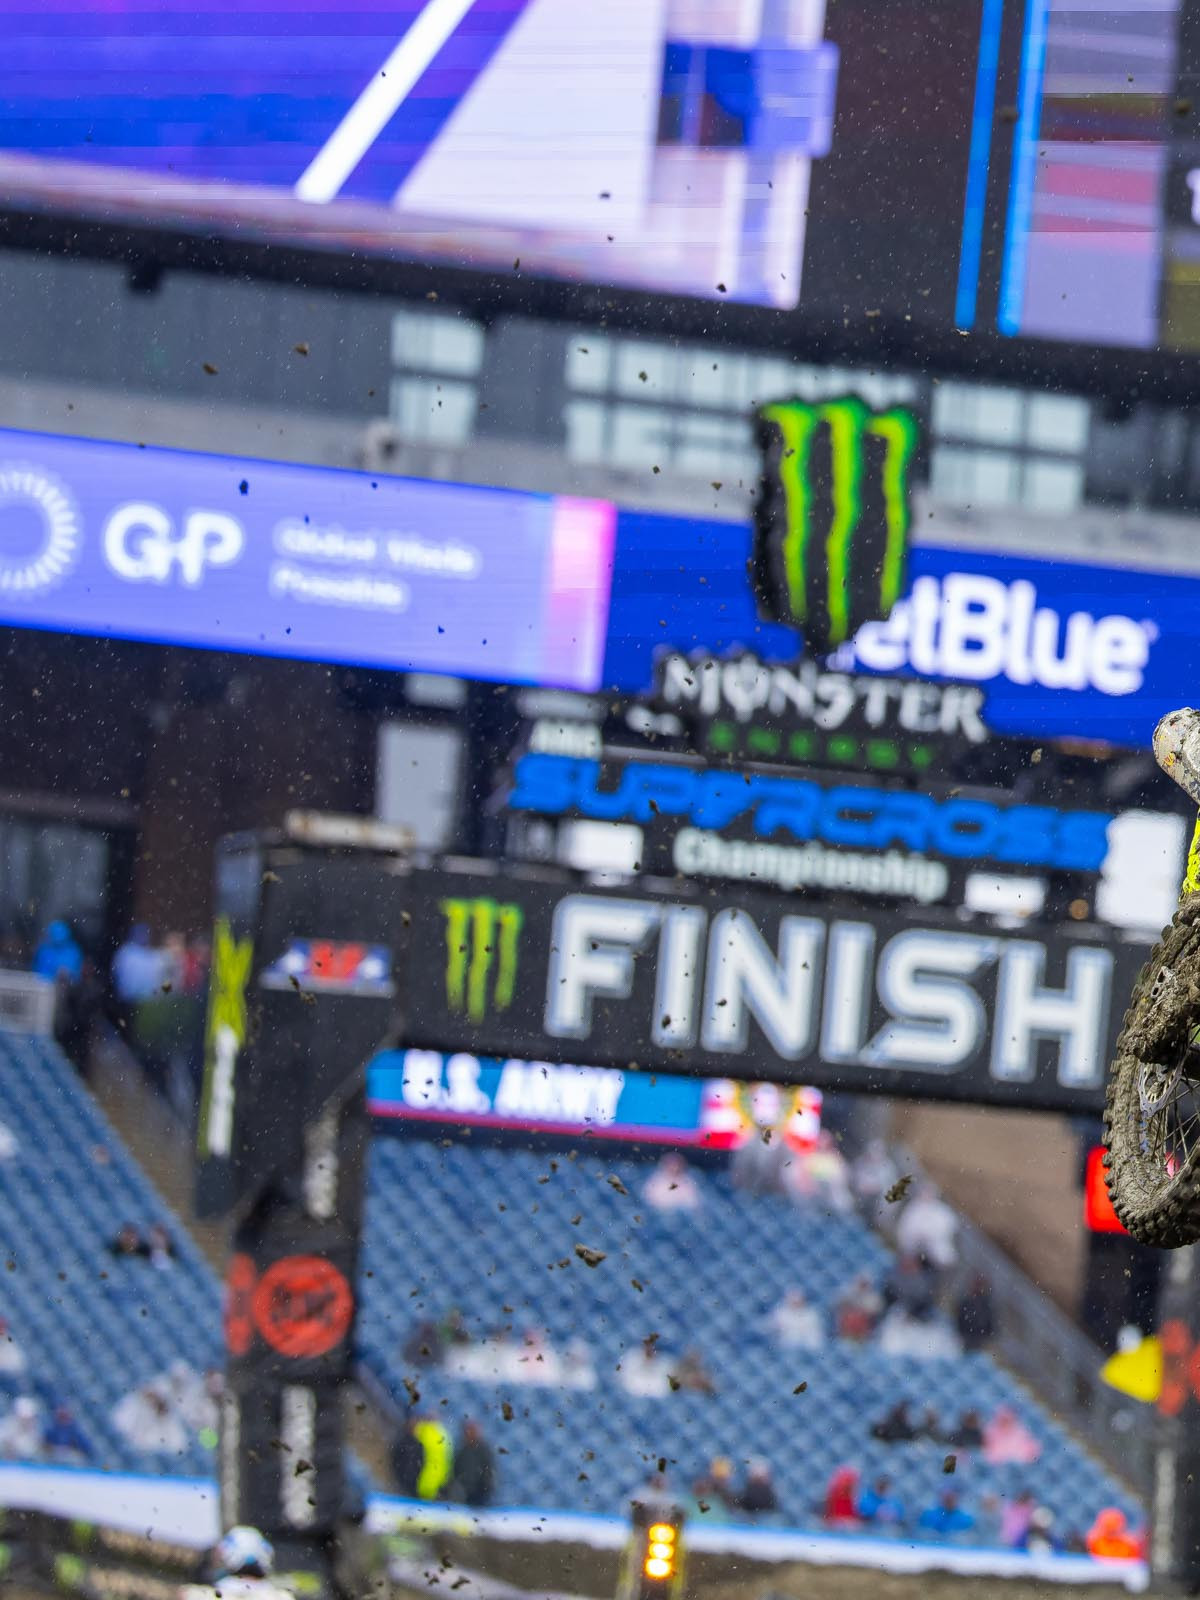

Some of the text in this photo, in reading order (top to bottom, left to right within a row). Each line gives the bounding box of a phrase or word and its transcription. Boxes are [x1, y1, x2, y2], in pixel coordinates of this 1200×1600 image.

[663, 653, 987, 744] MONSTER
[672, 825, 950, 903] Championship
[544, 892, 1114, 1091] FINISH
[402, 1048, 492, 1115] U.S.
